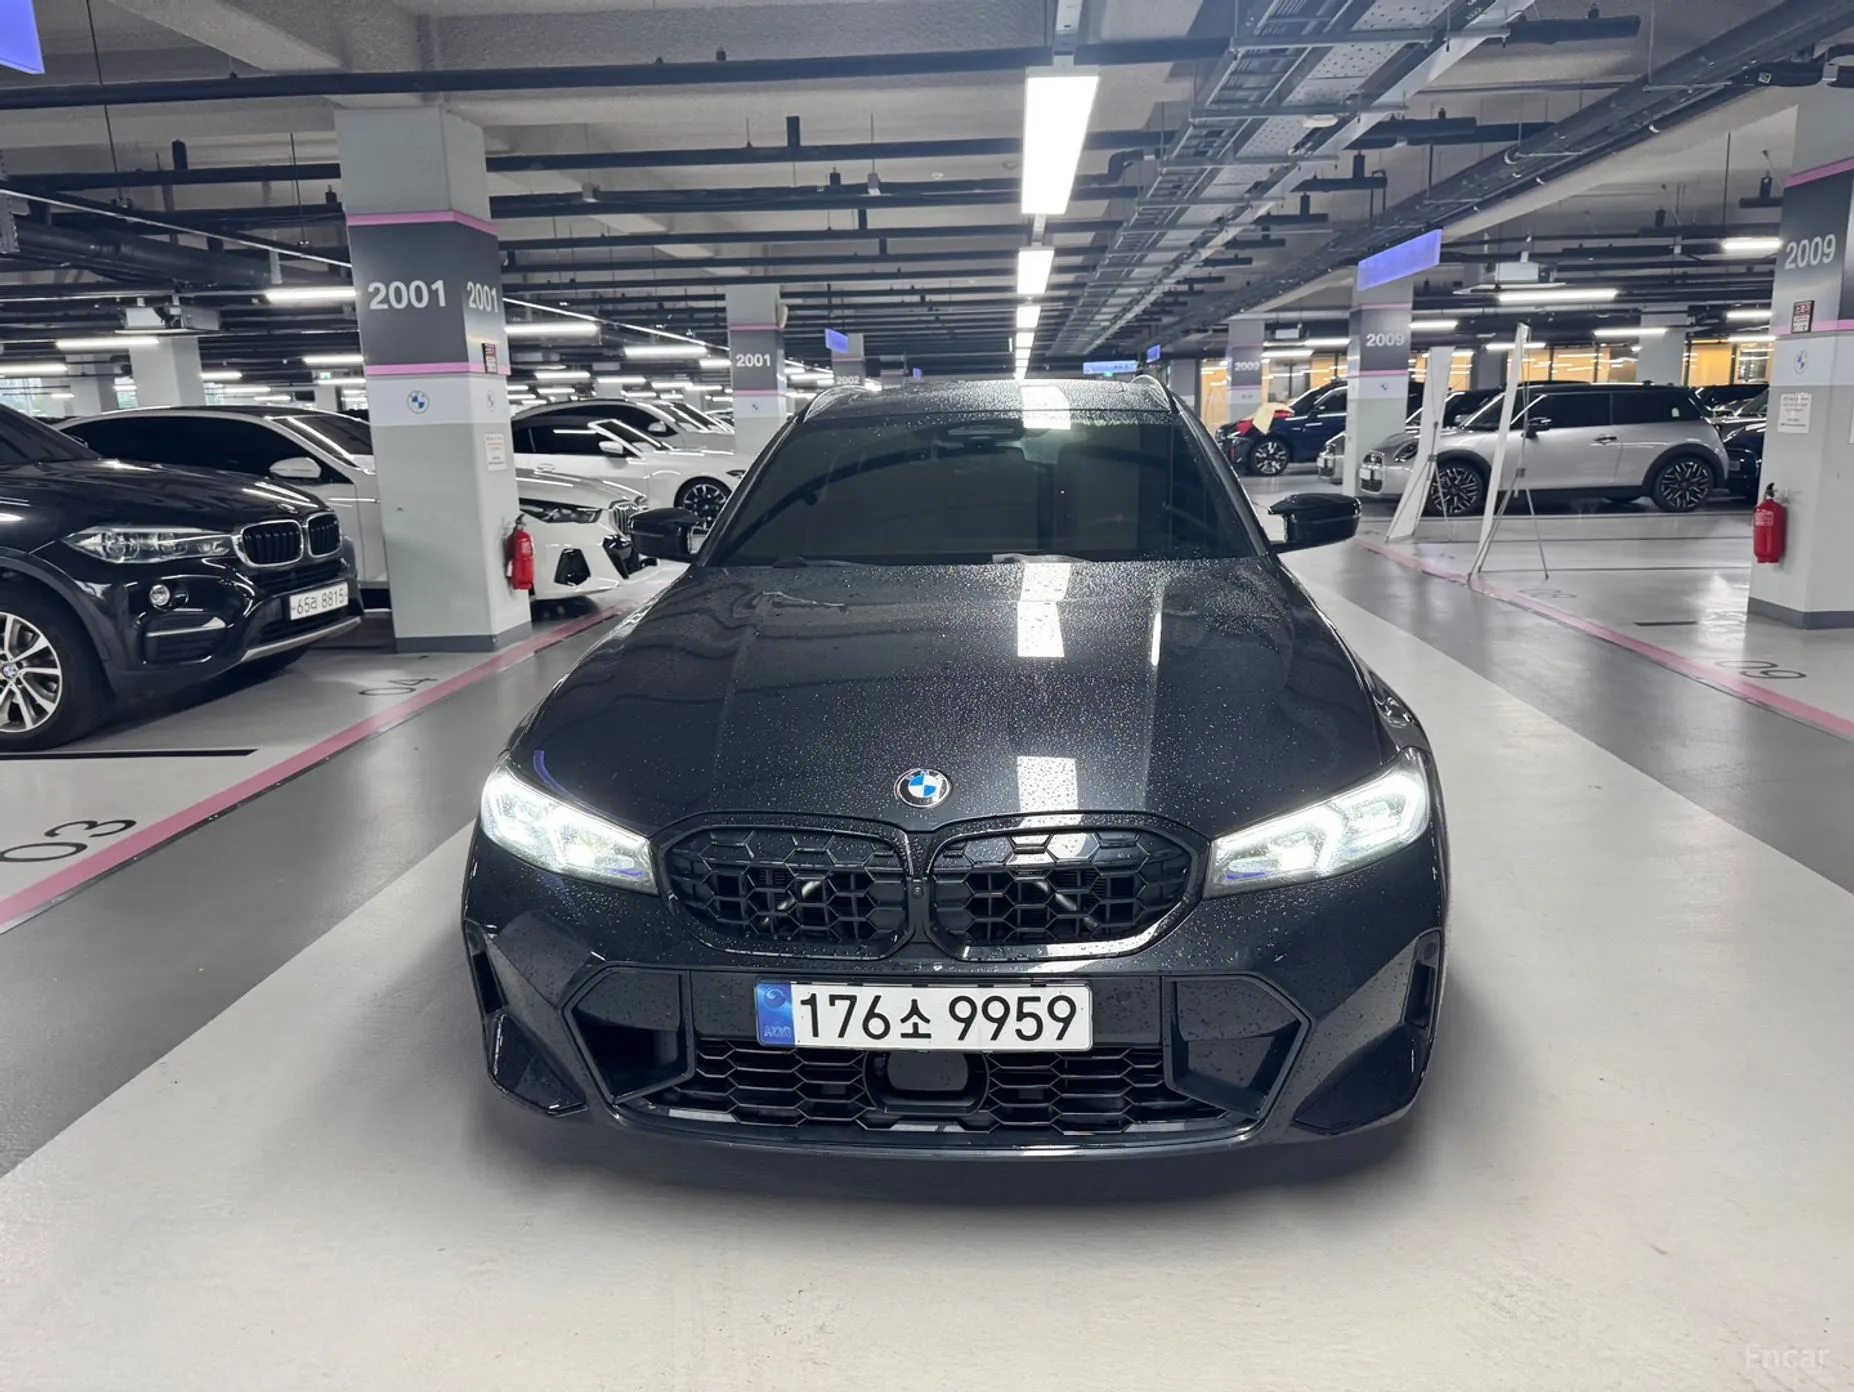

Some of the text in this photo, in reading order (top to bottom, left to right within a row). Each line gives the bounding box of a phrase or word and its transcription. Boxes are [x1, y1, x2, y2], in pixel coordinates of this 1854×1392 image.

[1784, 233, 1836, 270] 2009
[367, 280, 446, 310] 2001
[466, 281, 499, 313] 2001
[1365, 333, 1406, 348] 2009
[735, 353, 771, 367] 2001
[1234, 361, 1260, 371] 2009
[836, 375, 860, 385] 2002
[321, 588, 344, 609] 8815
[1714, 659, 1807, 679] 09
[0, 819, 137, 862] 03
[800, 992, 1077, 1041] 176소 9959
